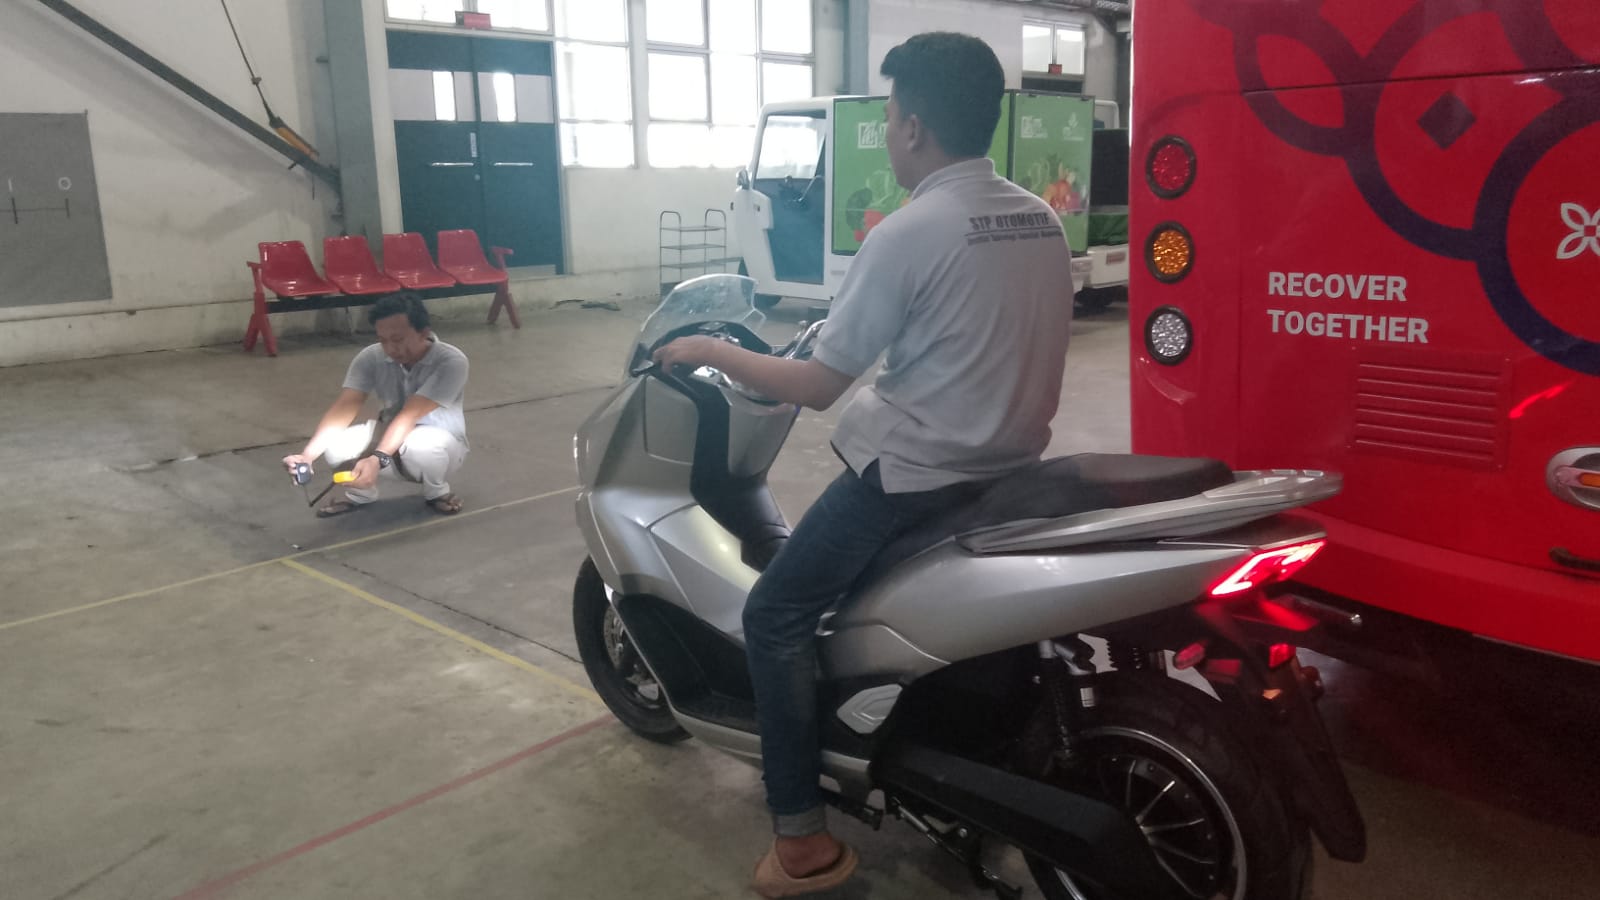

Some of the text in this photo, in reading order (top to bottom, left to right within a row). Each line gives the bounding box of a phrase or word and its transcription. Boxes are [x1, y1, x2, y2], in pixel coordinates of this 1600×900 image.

[968, 212, 1049, 231] STP OTOMOTIF
[1268, 271, 1408, 302] RECOVER
[1266, 309, 1430, 344] TOGETHER
